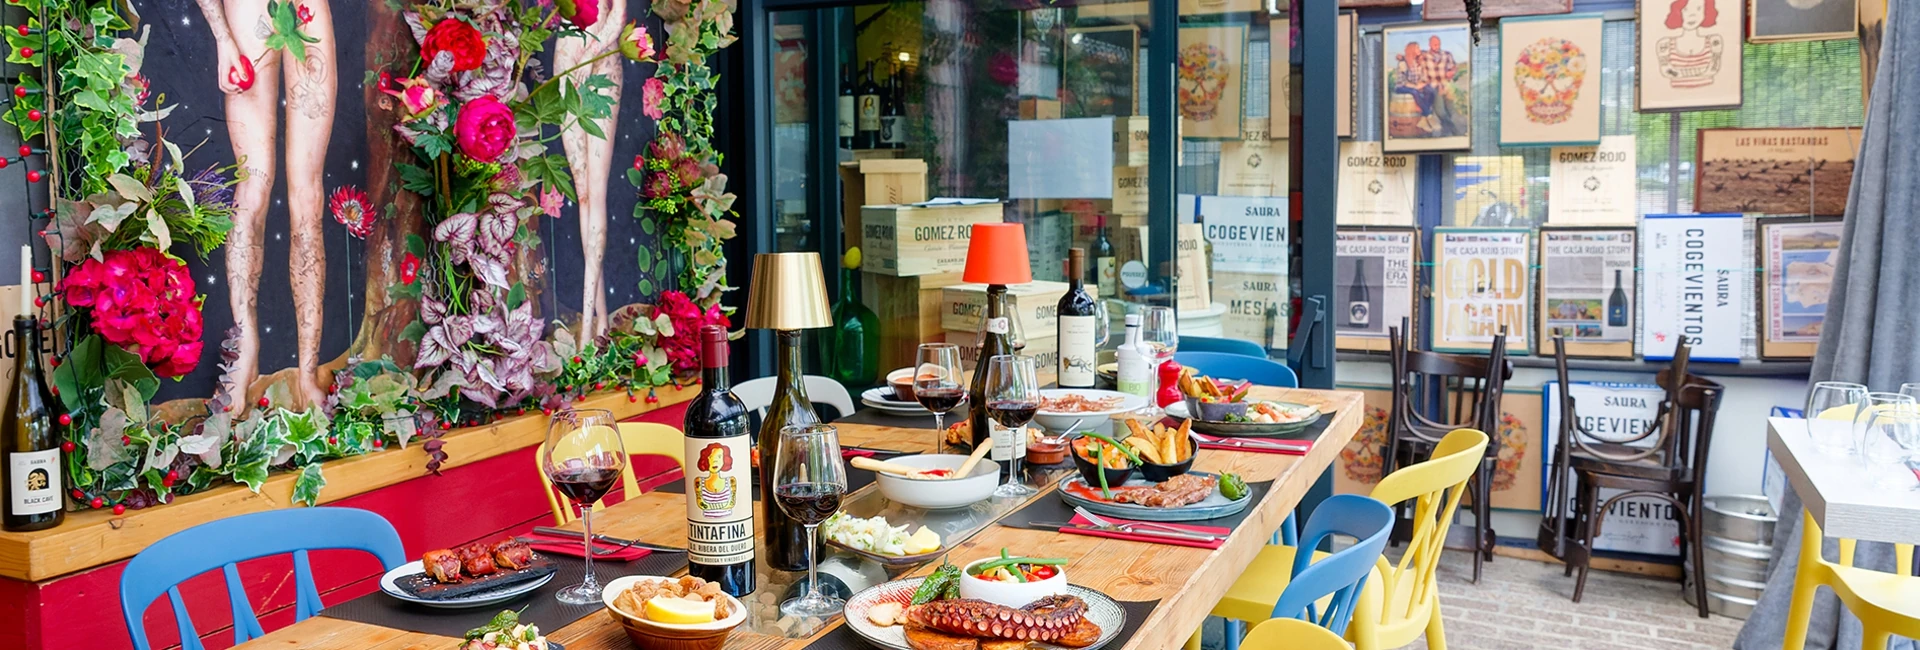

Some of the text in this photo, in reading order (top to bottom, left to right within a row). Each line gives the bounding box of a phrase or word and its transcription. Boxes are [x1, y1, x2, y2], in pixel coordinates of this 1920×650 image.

[1735, 137, 1750, 147] LAS
[1780, 136, 1829, 146] BASTARDAS
[1347, 156, 1406, 168] GOMEZ ROJO
[1559, 151, 1626, 163] GOMEZ ROJO
[1245, 206, 1280, 216] SAURA
[914, 224, 972, 241] GOMEZ RO
[1178, 240, 1198, 251] ROJO
[1349, 245, 1366, 254] CASA
[1388, 246, 1410, 254] STORY
[1445, 247, 1458, 255] THE
[1500, 247, 1524, 255] STORY
[1548, 246, 1560, 254] THE
[1563, 246, 1584, 254] CASA
[1607, 246, 1631, 254] STORY
[1387, 260, 1408, 268] THE
[1386, 272, 1408, 280] ERA
[1445, 258, 1524, 300] GOLD
[1243, 280, 1278, 292] SAURA
[1684, 228, 1704, 346] COGEVIENTOS
[1716, 268, 1730, 308] SAURA
[953, 302, 982, 318] GOMEZ
[1036, 304, 1058, 320] GOME
[1230, 298, 1288, 317] MESÍAS
[1034, 352, 1058, 369] GOME
[1604, 396, 1647, 408] SAURA
[689, 523, 746, 540] TINTAFINA
[698, 544, 718, 553] RIBERA
[718, 545, 730, 553] DEL
[730, 542, 747, 552] DUERO
